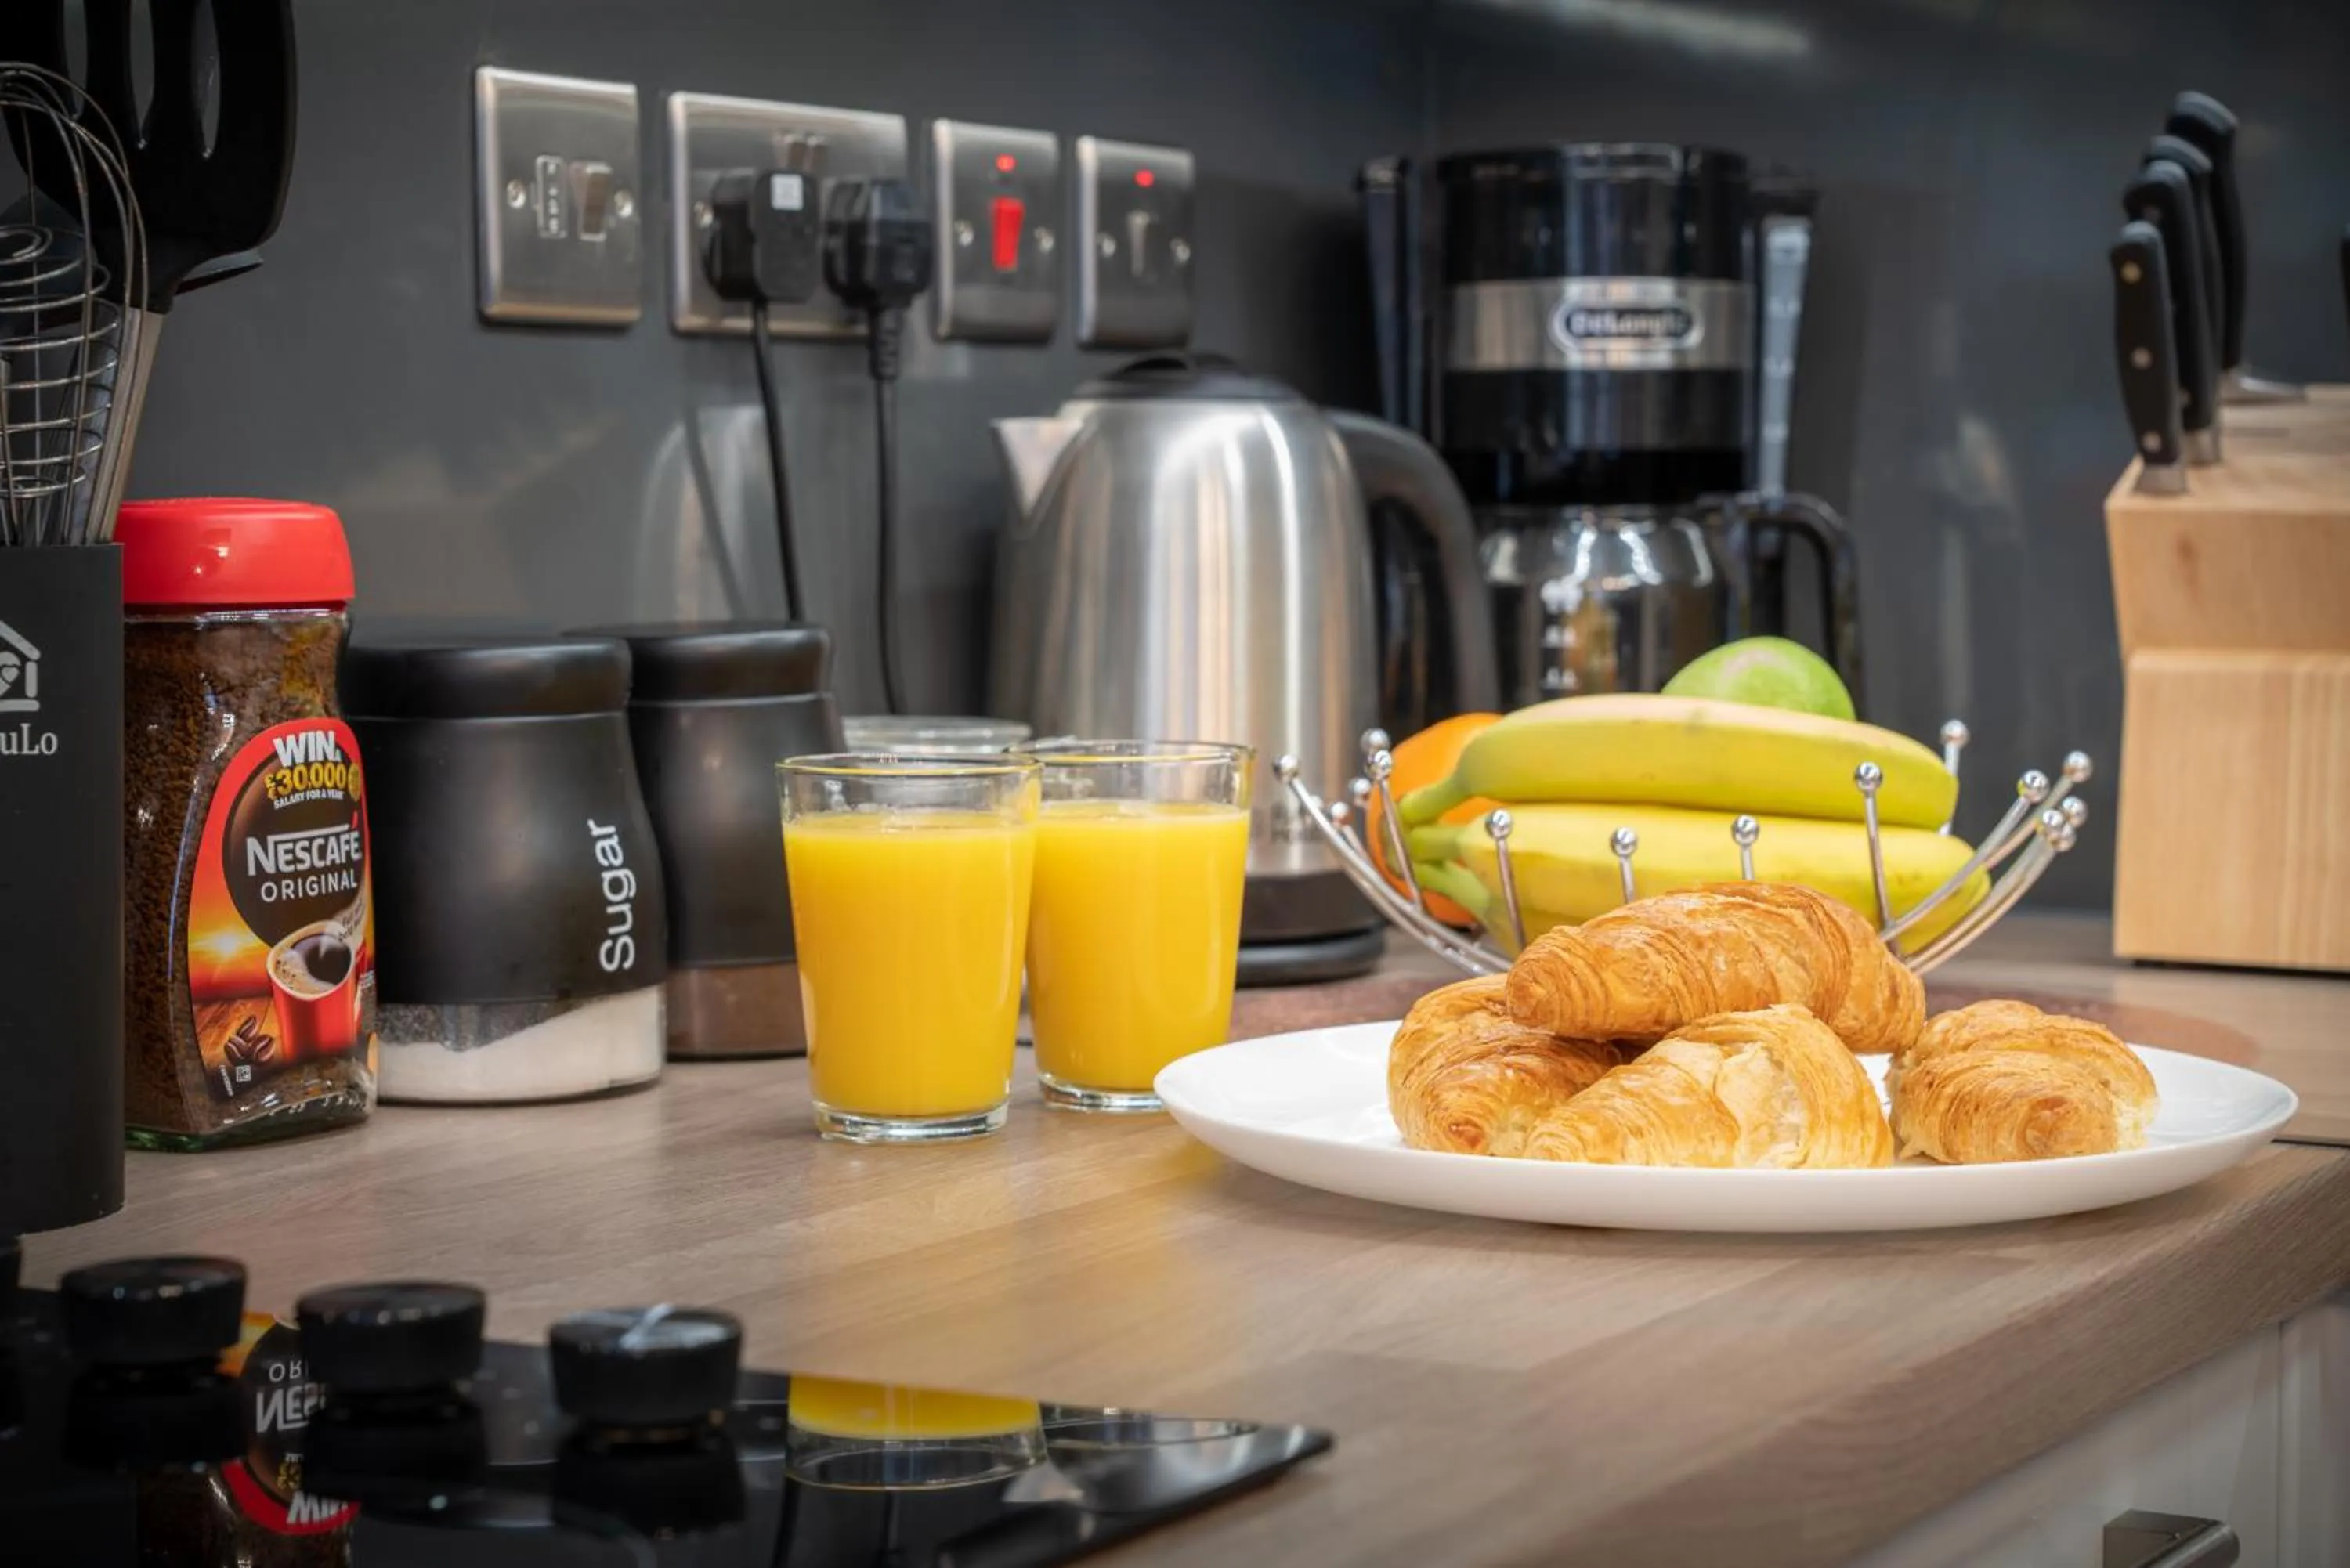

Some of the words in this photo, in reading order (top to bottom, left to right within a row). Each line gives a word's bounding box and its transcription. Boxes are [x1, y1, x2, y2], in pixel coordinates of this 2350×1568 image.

[273, 730, 335, 767] WIN
[274, 793, 305, 810] SALARY
[261, 869, 357, 902] ORIGINAL
[588, 818, 637, 972] Sugar
